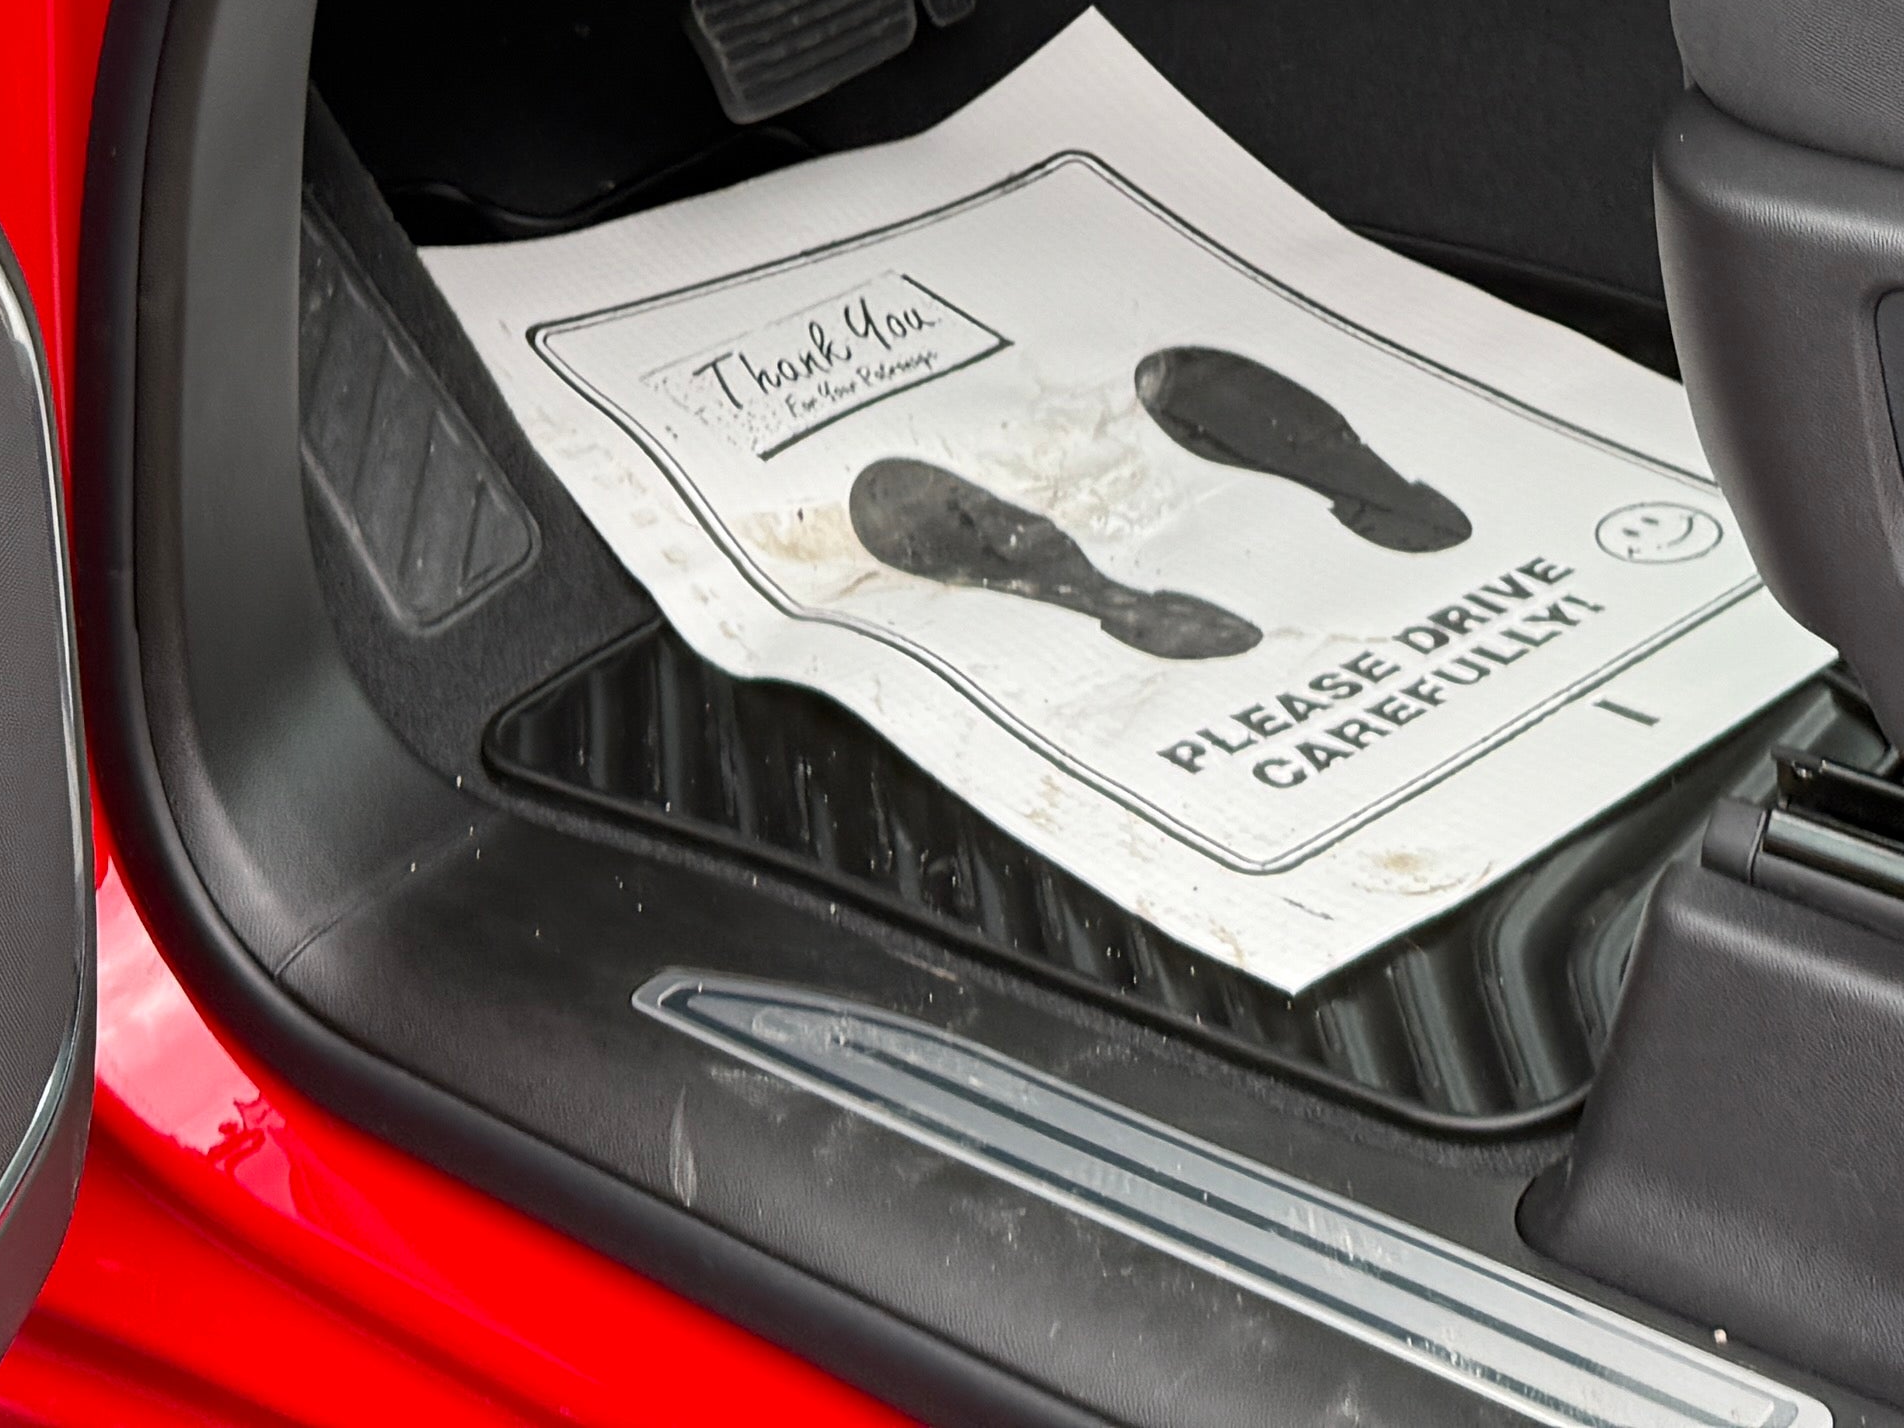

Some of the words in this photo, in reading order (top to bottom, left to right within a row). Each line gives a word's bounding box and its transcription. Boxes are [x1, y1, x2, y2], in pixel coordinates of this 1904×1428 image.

[692, 320, 853, 410] Thank
[844, 297, 936, 351] You
[1156, 649, 1402, 775] PLEASE
[1392, 556, 1576, 656] DRIVE
[1251, 594, 1606, 789] CAREFULLY!
